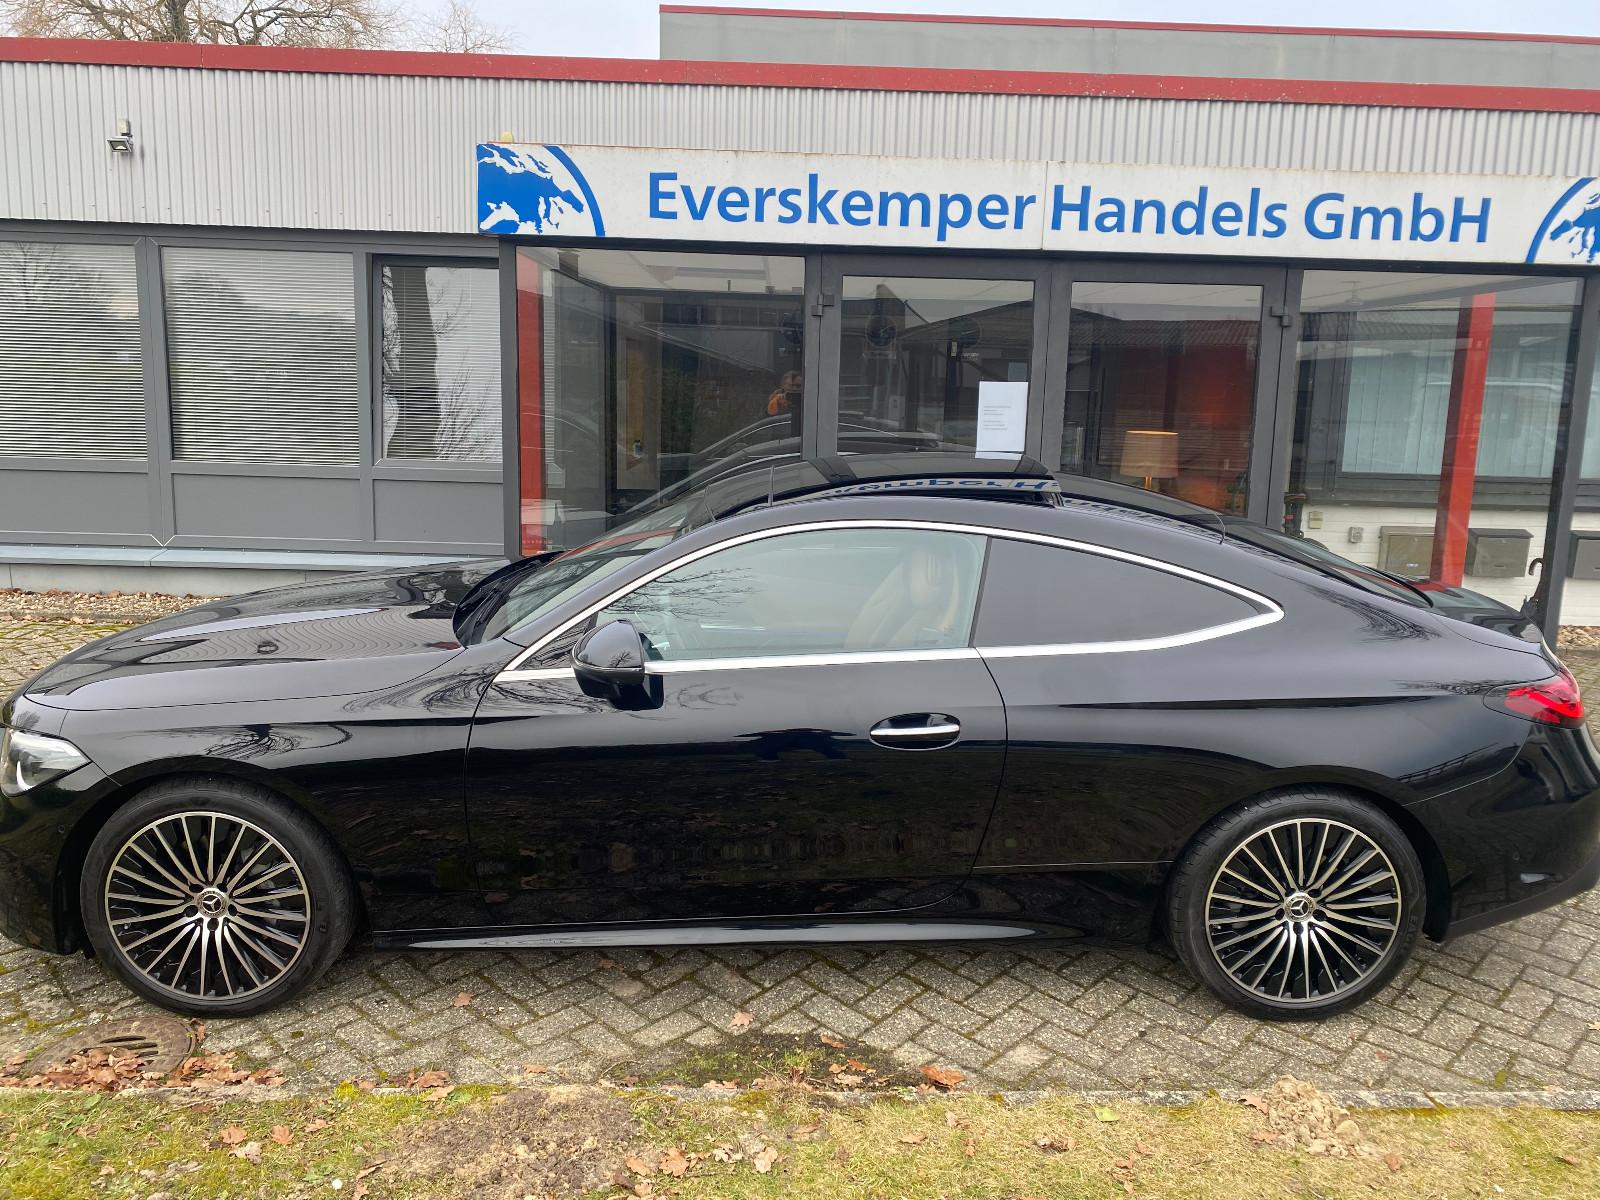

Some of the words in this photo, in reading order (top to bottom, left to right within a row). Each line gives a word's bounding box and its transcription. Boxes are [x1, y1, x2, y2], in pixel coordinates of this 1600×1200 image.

[648, 171, 1037, 242] Everskemper
[1050, 184, 1287, 239] Handels
[1304, 192, 1491, 243] GmbH
